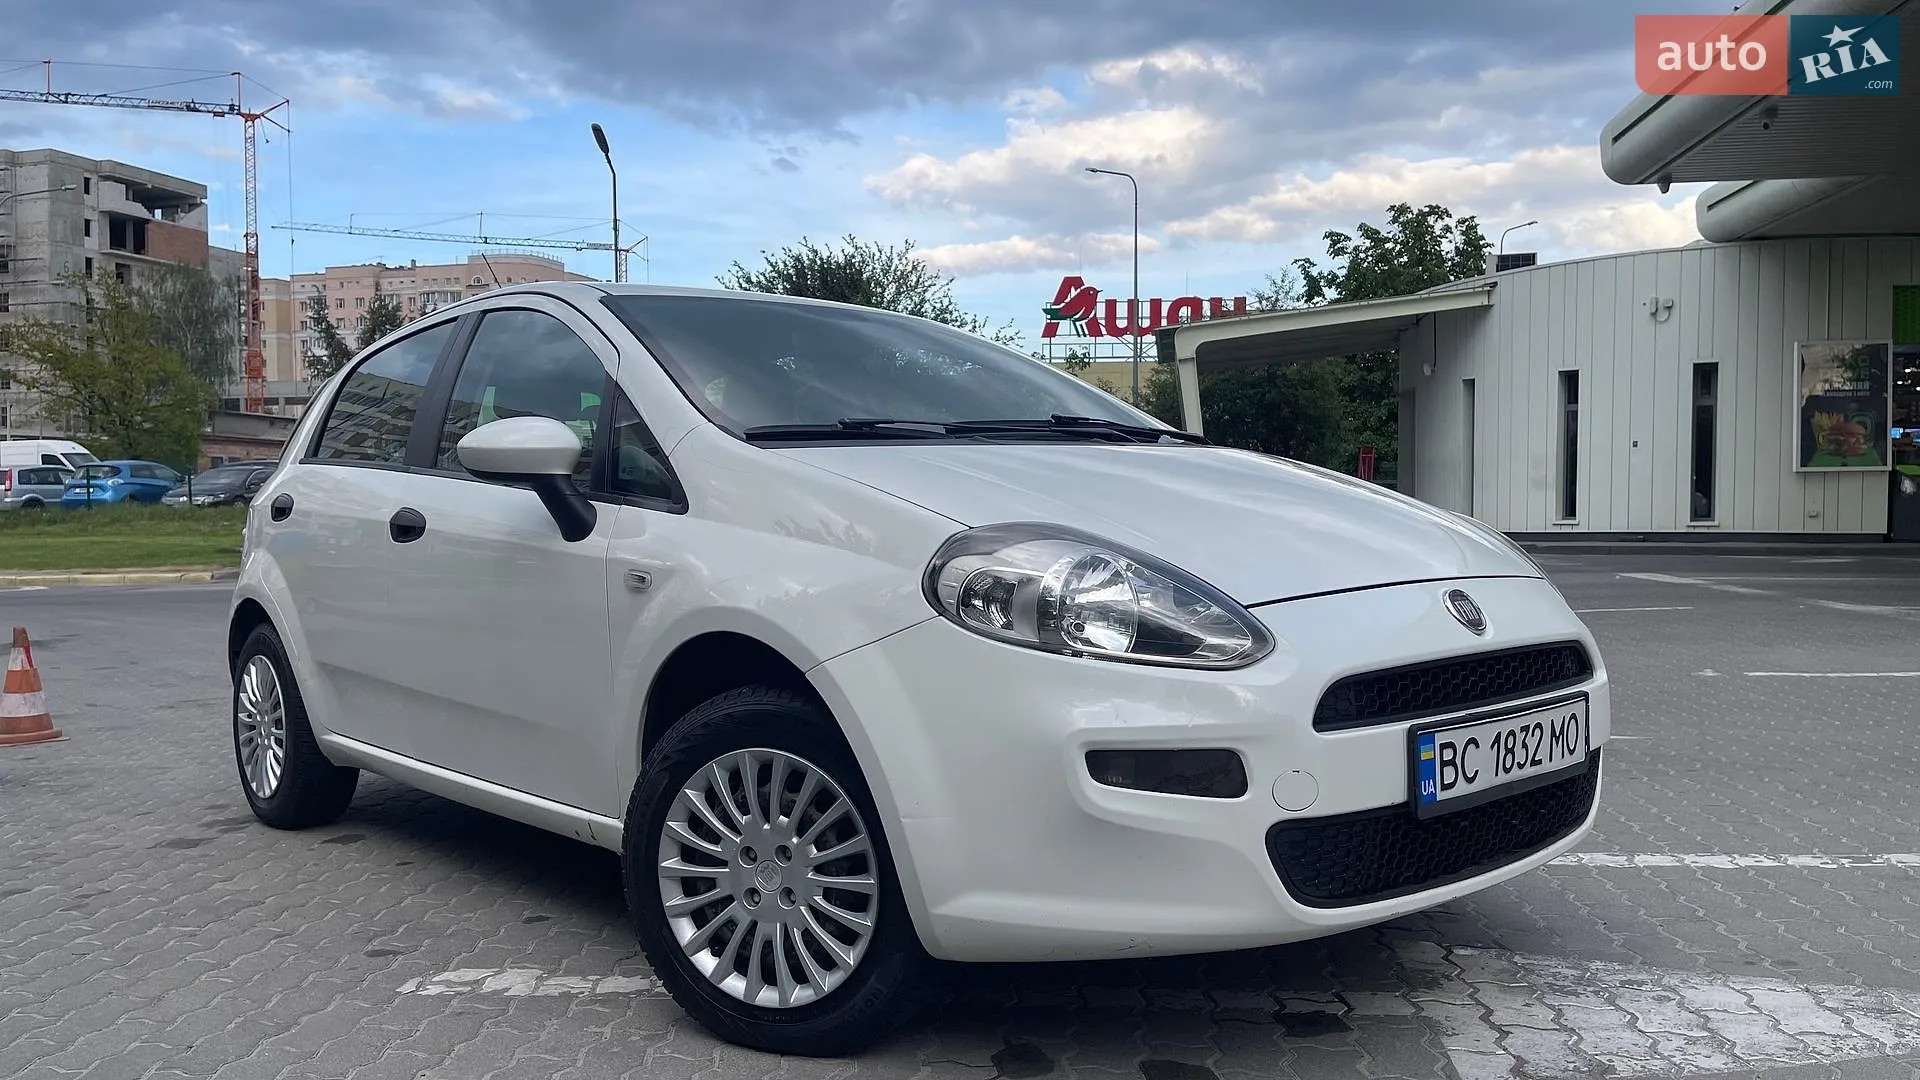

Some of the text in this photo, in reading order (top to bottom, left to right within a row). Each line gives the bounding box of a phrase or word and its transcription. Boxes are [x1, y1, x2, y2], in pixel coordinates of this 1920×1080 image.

[1439, 712, 1579, 792] BC 1832 MO
[1421, 778, 1435, 795] UA
